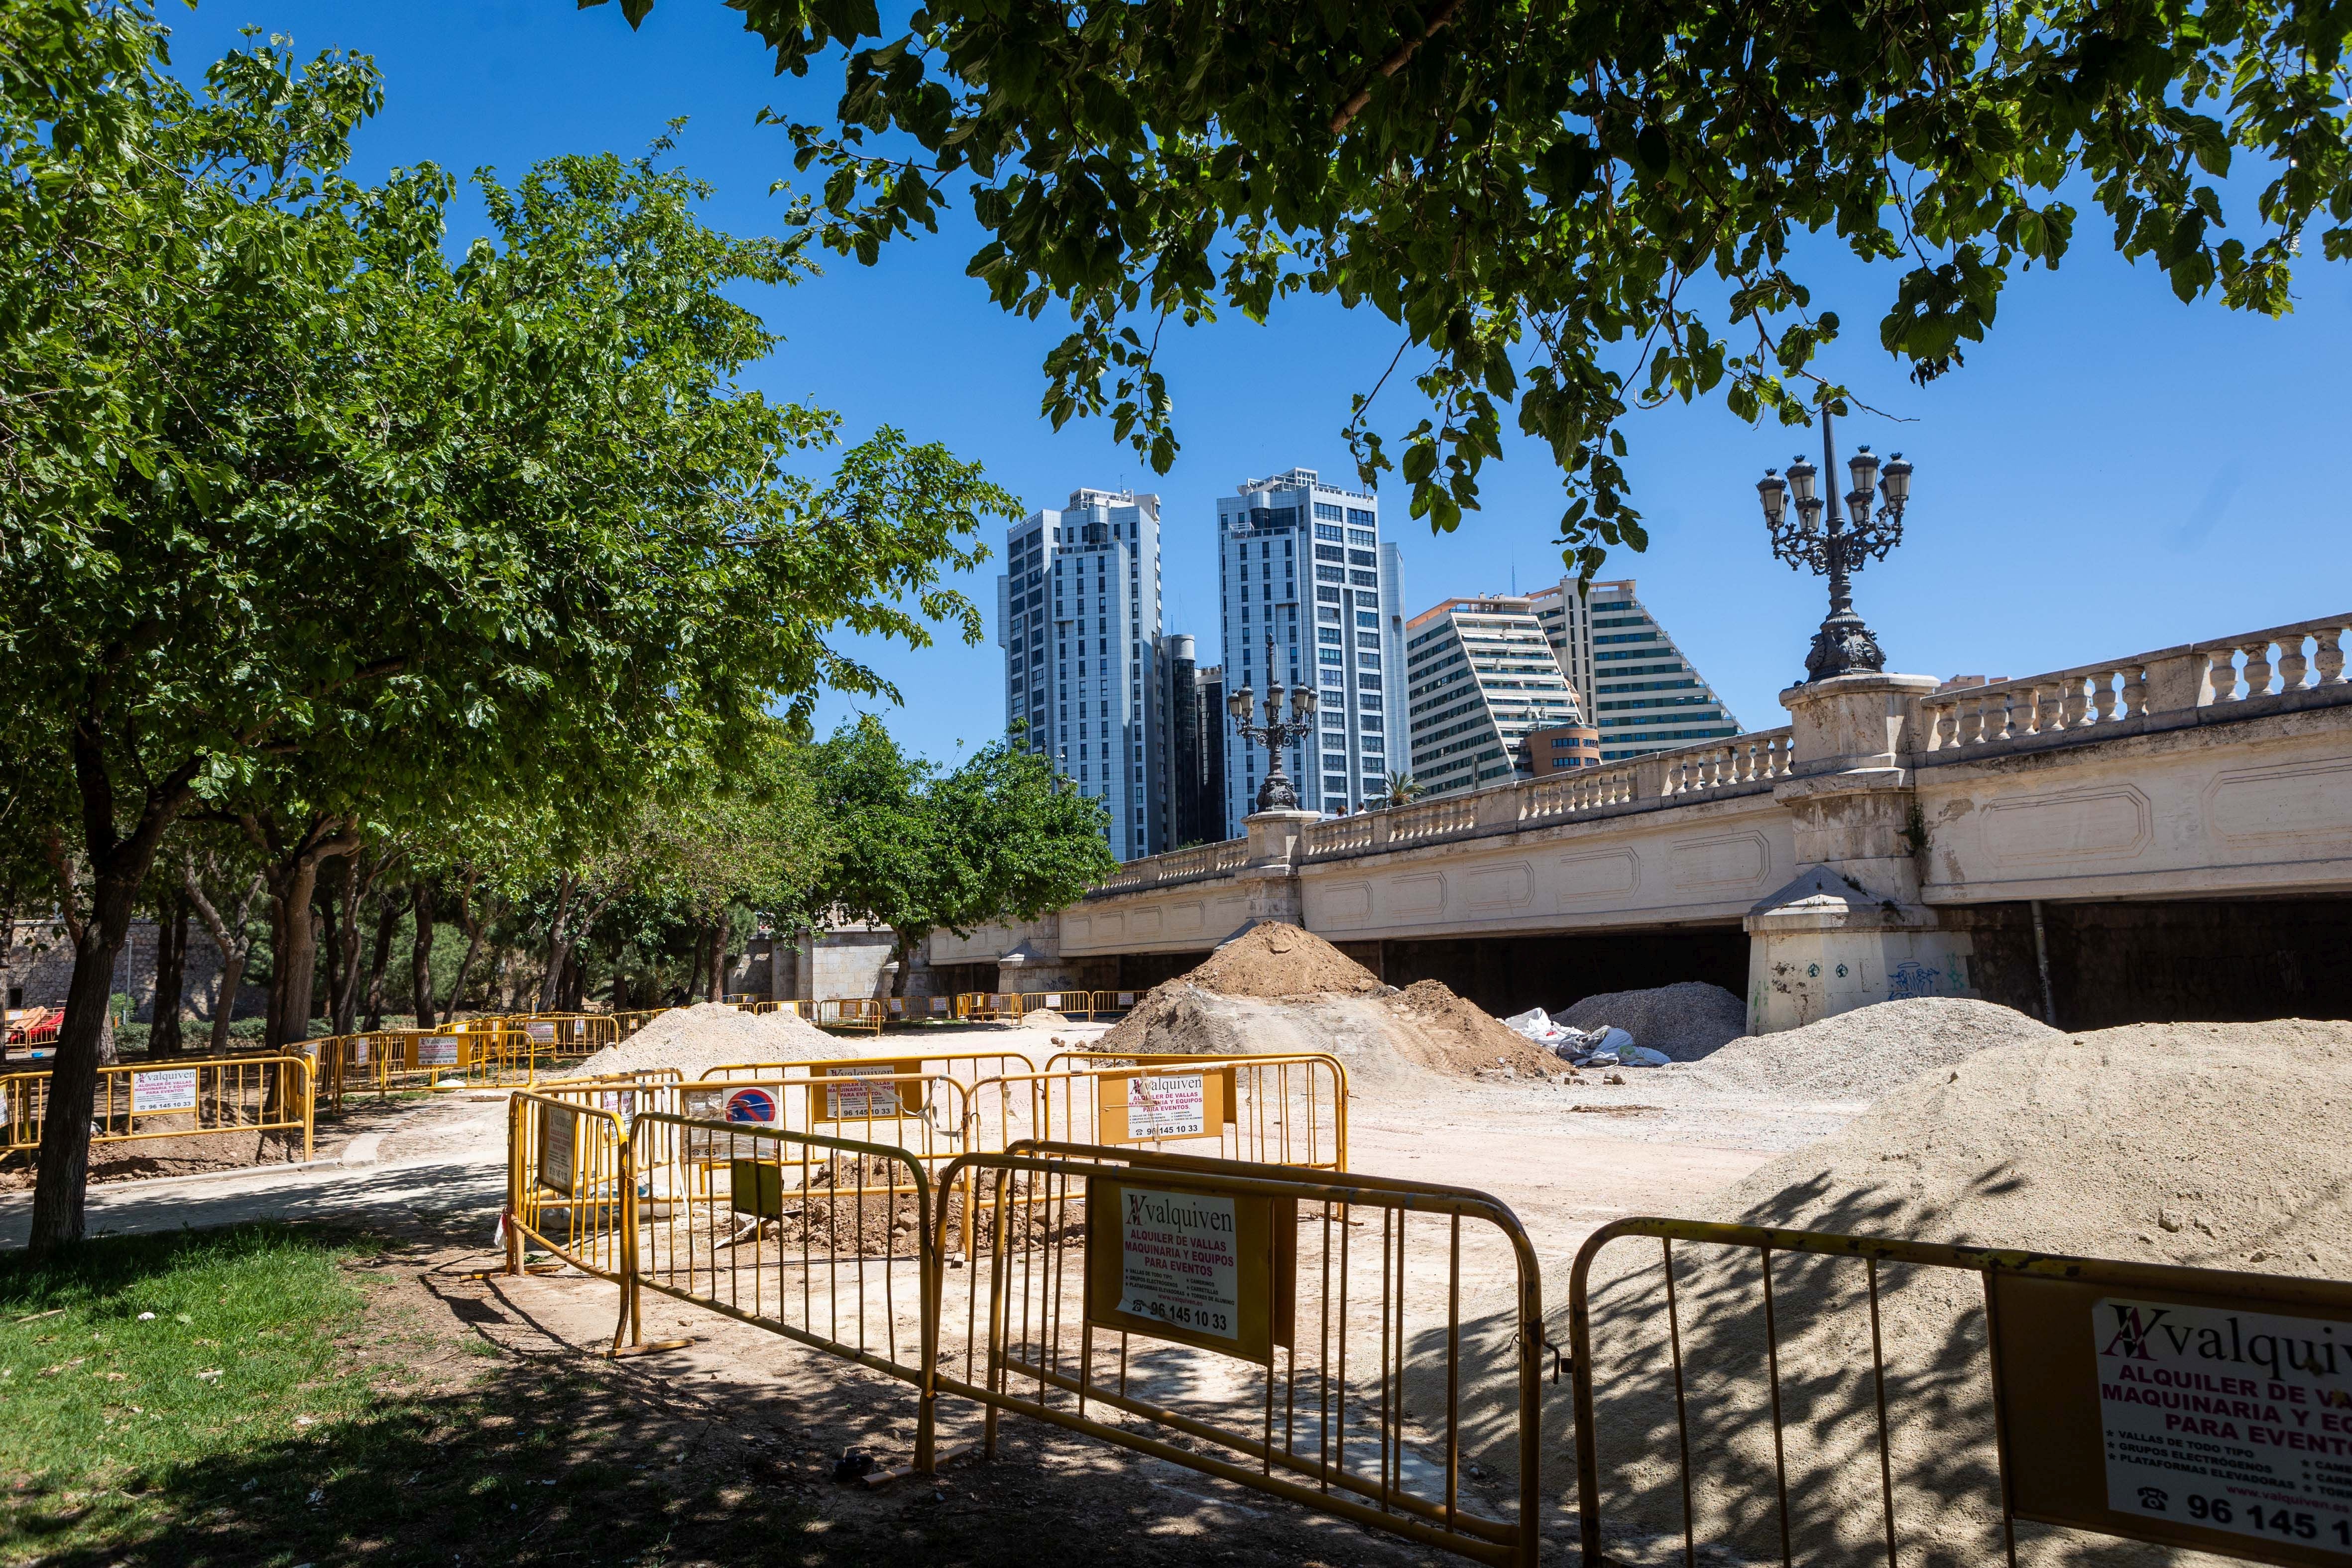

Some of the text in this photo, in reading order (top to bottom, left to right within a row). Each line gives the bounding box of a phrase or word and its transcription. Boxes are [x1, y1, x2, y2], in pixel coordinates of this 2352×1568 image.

[147, 1071, 195, 1082] valquiven
[1145, 1077, 1202, 1093] valquiven
[1145, 1199, 1233, 1233] valquiven
[1131, 1229, 1226, 1252] ALQUILER DE VALLAS
[1125, 1241, 1234, 1267] MAQUINARIA Y EQUIPOS
[1145, 1256, 1213, 1277] PARA EVENTOS
[1130, 1282, 1184, 1296] PLATAFORMAS ELEVADORAS
[1158, 1294, 1203, 1306] www.valquiven.es
[1190, 1286, 1218, 1295] CARRETILLAS
[1214, 1297, 1234, 1305] ALUMINIO
[1150, 1302, 1226, 1330] 96 145 10 33
[2119, 1365, 2259, 1398] ALQUILER
[2268, 1383, 2306, 1404] DE
[2102, 1384, 2281, 1425] MAQUINARIA
[2290, 1408, 2310, 1427] Y
[2118, 1430, 2254, 1457] VALLAS DE TODO TIPO
[2165, 1414, 2352, 1455] PARA EVENT
[2119, 1443, 2168, 1457] GRUPOS
[2120, 1454, 2295, 1489] PLATAFORMAS ELEVADORAS
[2226, 1485, 2350, 1513] www.valquiven.es
[2187, 1495, 2233, 1523] 96
[2247, 1505, 2316, 1539] 145
